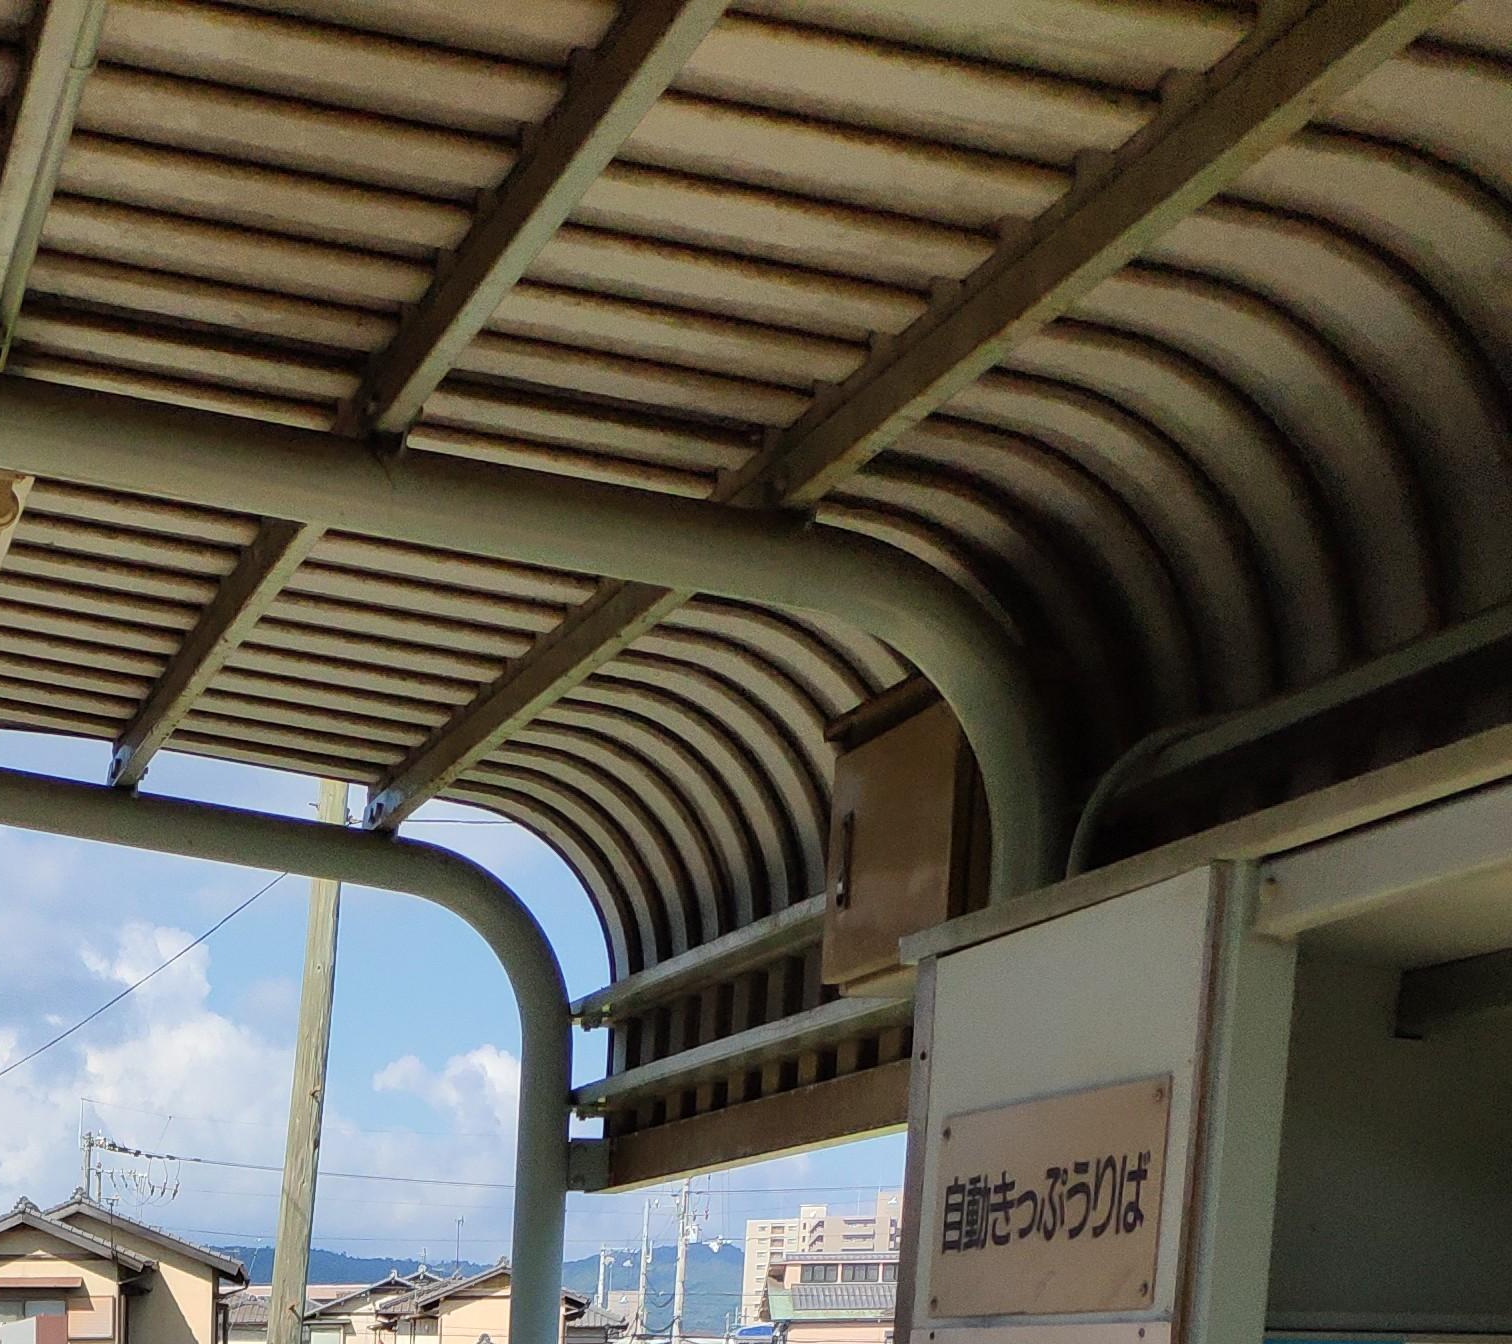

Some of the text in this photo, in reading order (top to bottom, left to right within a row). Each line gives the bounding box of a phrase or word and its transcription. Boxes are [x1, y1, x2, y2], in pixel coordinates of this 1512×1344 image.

[942, 1151, 1151, 1255] 自動きっぷうりば
